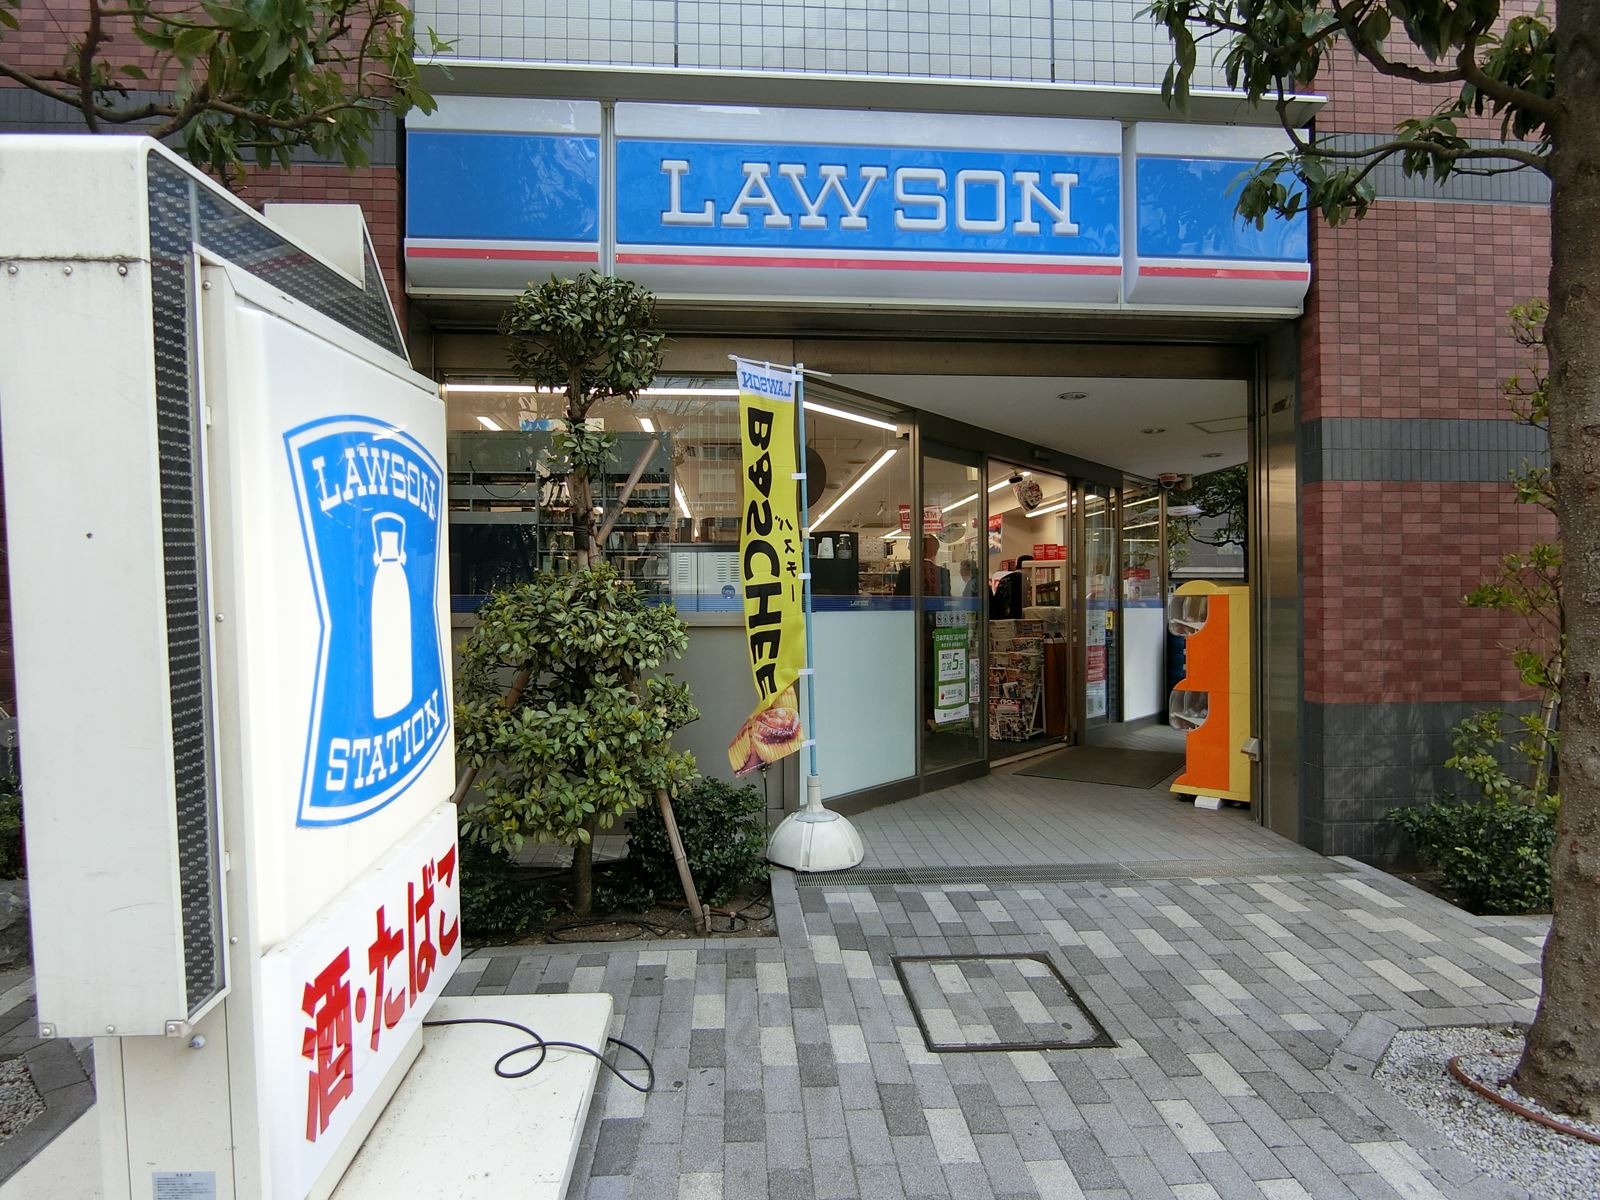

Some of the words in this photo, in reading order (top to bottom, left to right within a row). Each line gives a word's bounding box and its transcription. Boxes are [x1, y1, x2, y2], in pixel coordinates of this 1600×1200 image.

[661, 159, 1080, 236] LAWSON
[312, 445, 436, 521] LAWSON
[325, 688, 440, 791] STATION
[301, 842, 458, 1143] 酒・たばこ
